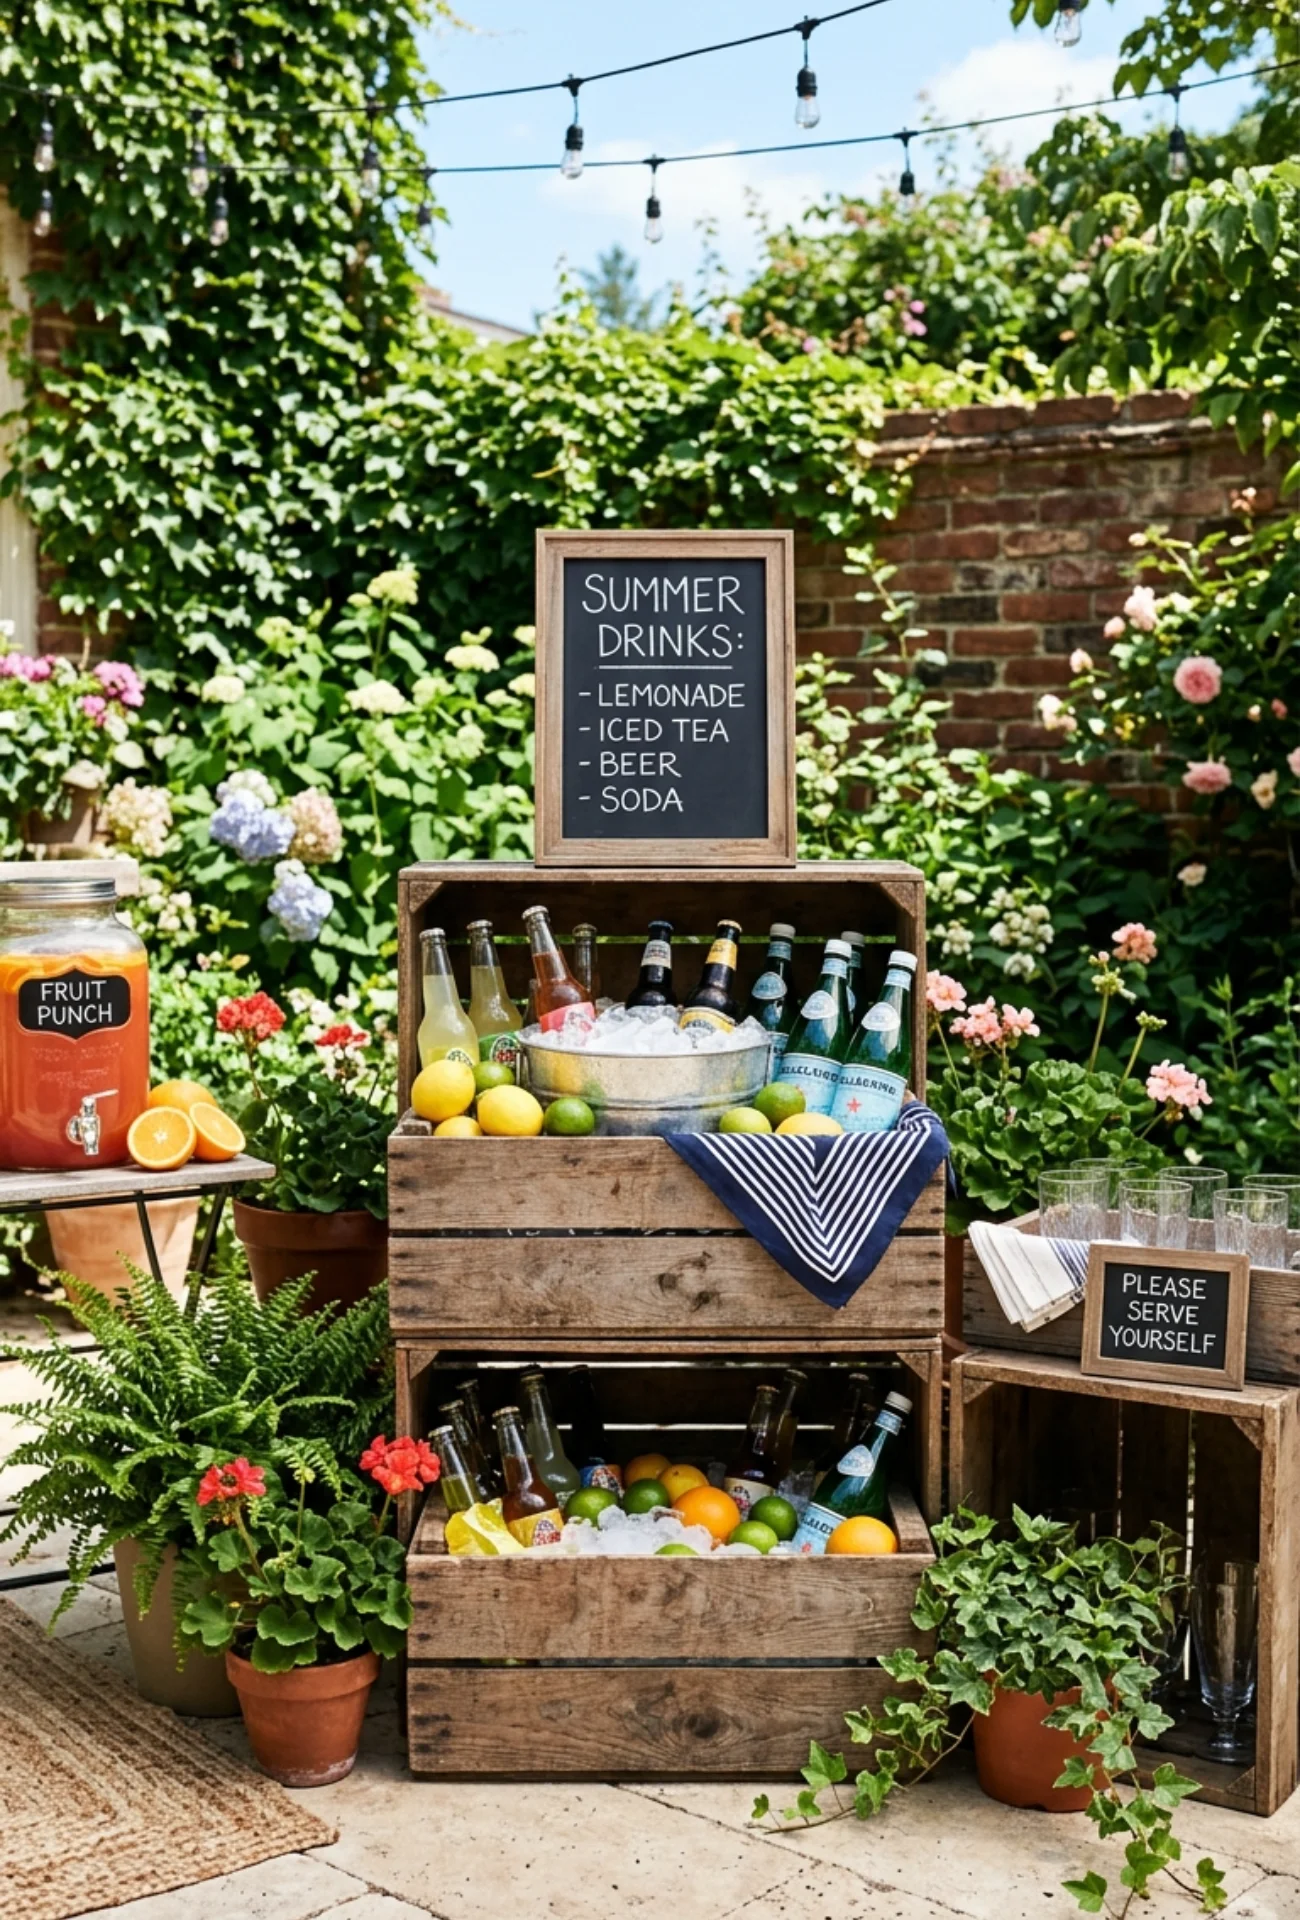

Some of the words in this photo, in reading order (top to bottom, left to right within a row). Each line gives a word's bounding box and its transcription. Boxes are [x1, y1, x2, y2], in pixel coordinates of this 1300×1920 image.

[581, 573, 745, 615] SUMMER
[598, 623, 744, 659] DRINKS:
[598, 683, 746, 708] LEMONADE
[599, 717, 663, 742] ICED
[671, 718, 730, 743] TEA
[599, 750, 683, 778] BEER
[600, 785, 684, 814] SODA
[40, 980, 107, 1002] FRUIT
[37, 1003, 112, 1026] PUNCH
[1122, 1272, 1207, 1300] PLEASE
[1127, 1300, 1200, 1326] SERVE
[1108, 1325, 1216, 1355] YOURSELF
